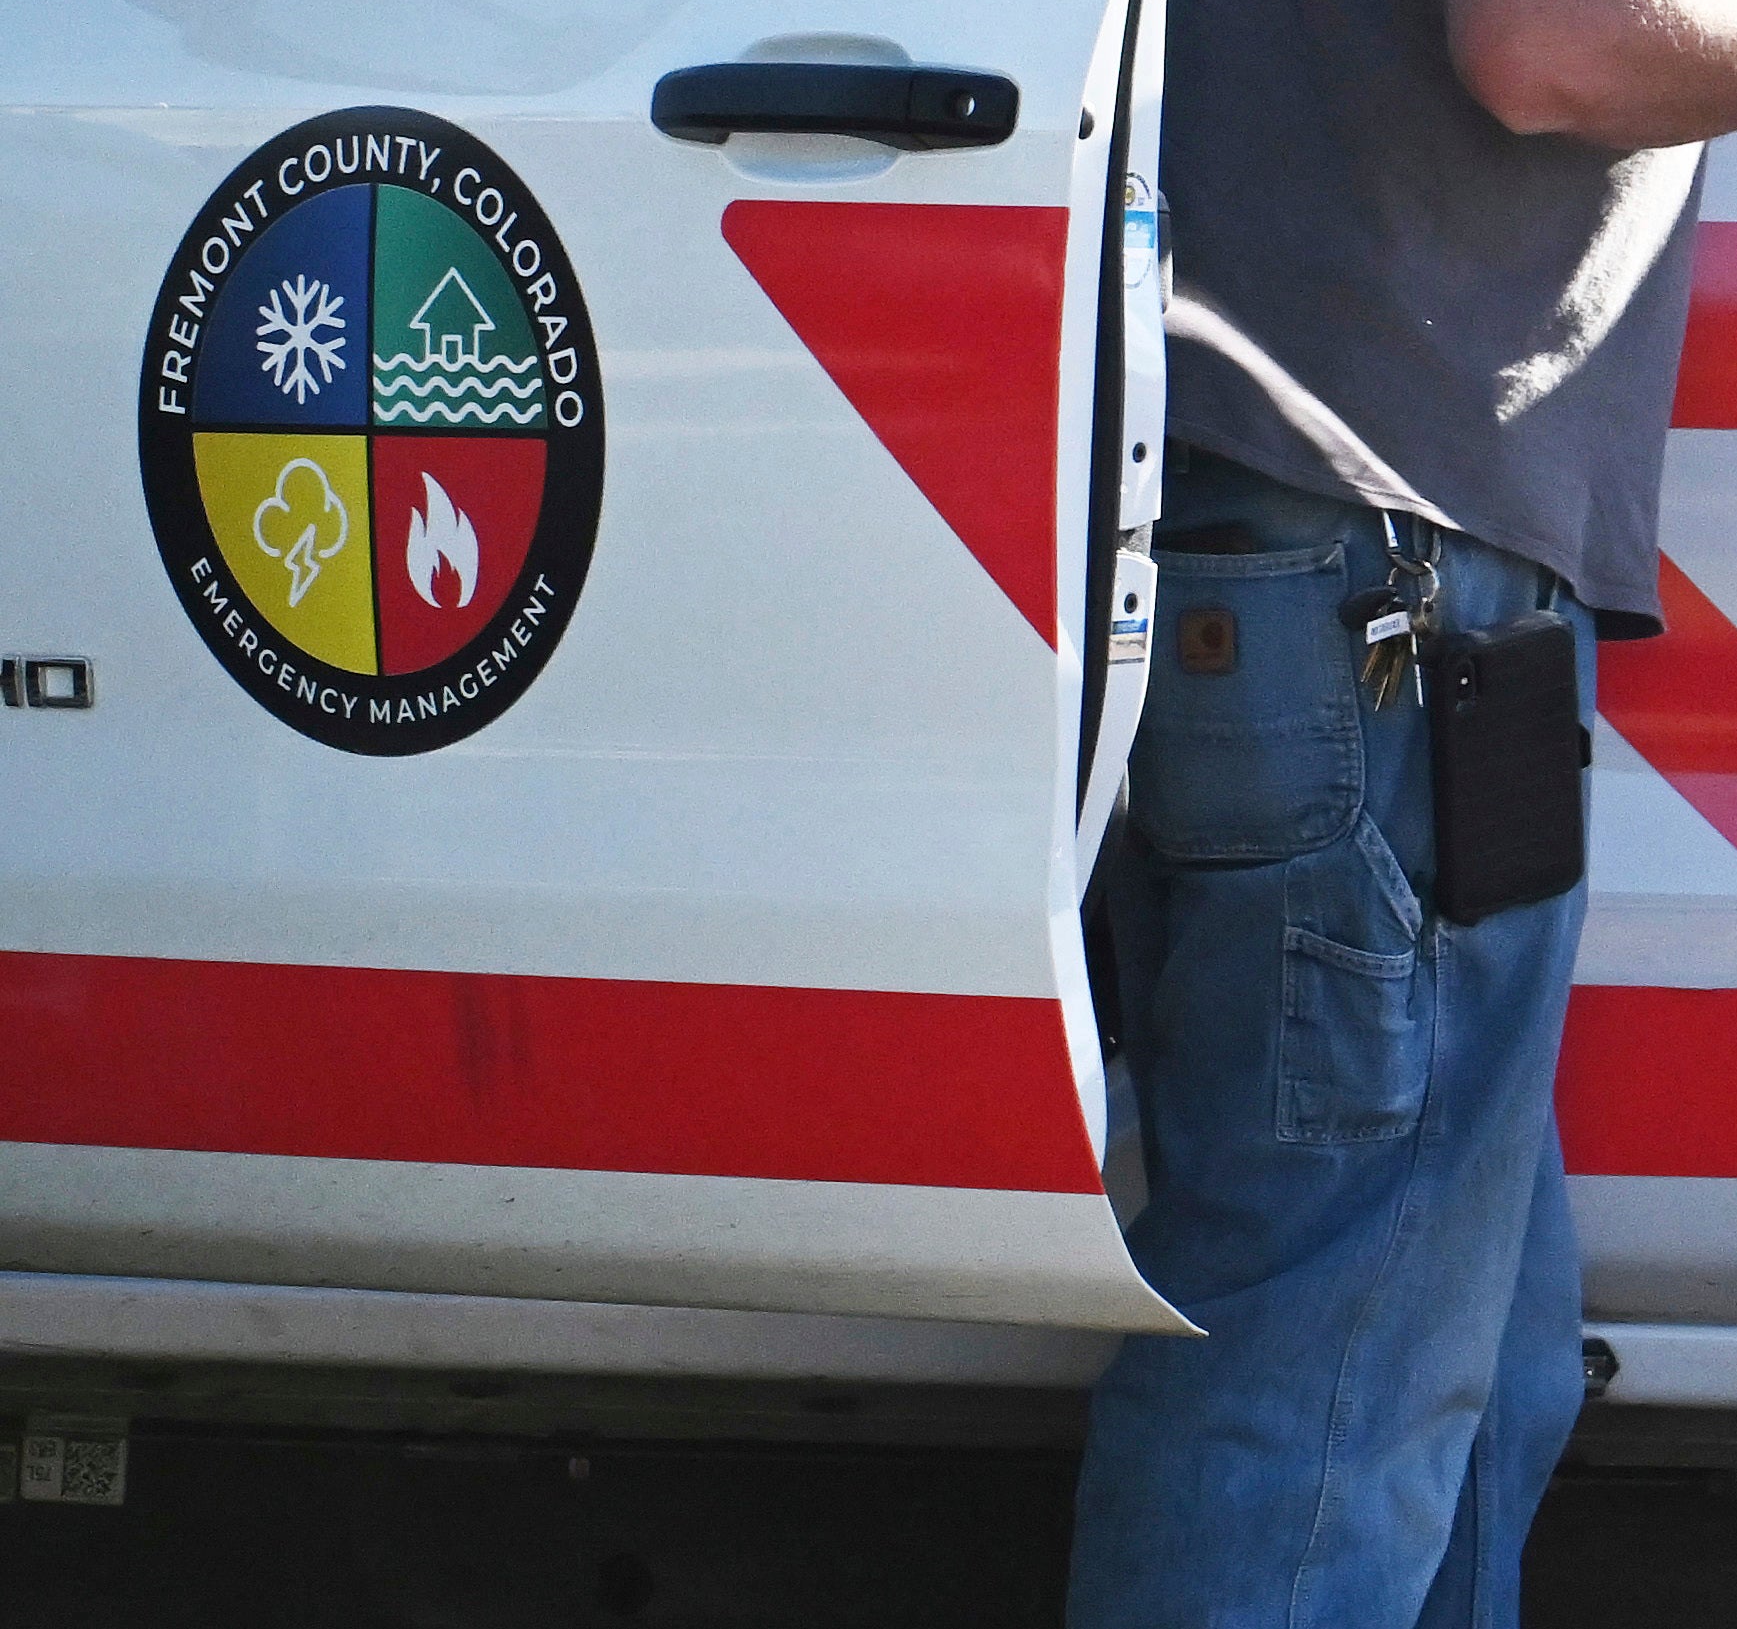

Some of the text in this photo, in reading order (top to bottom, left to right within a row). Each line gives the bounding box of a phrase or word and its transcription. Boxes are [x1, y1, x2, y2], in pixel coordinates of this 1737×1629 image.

[158, 133, 584, 428] FREMONT COUNTY, COLORADO
[190, 556, 556, 725] EMERGENCY MANAGEMENT
